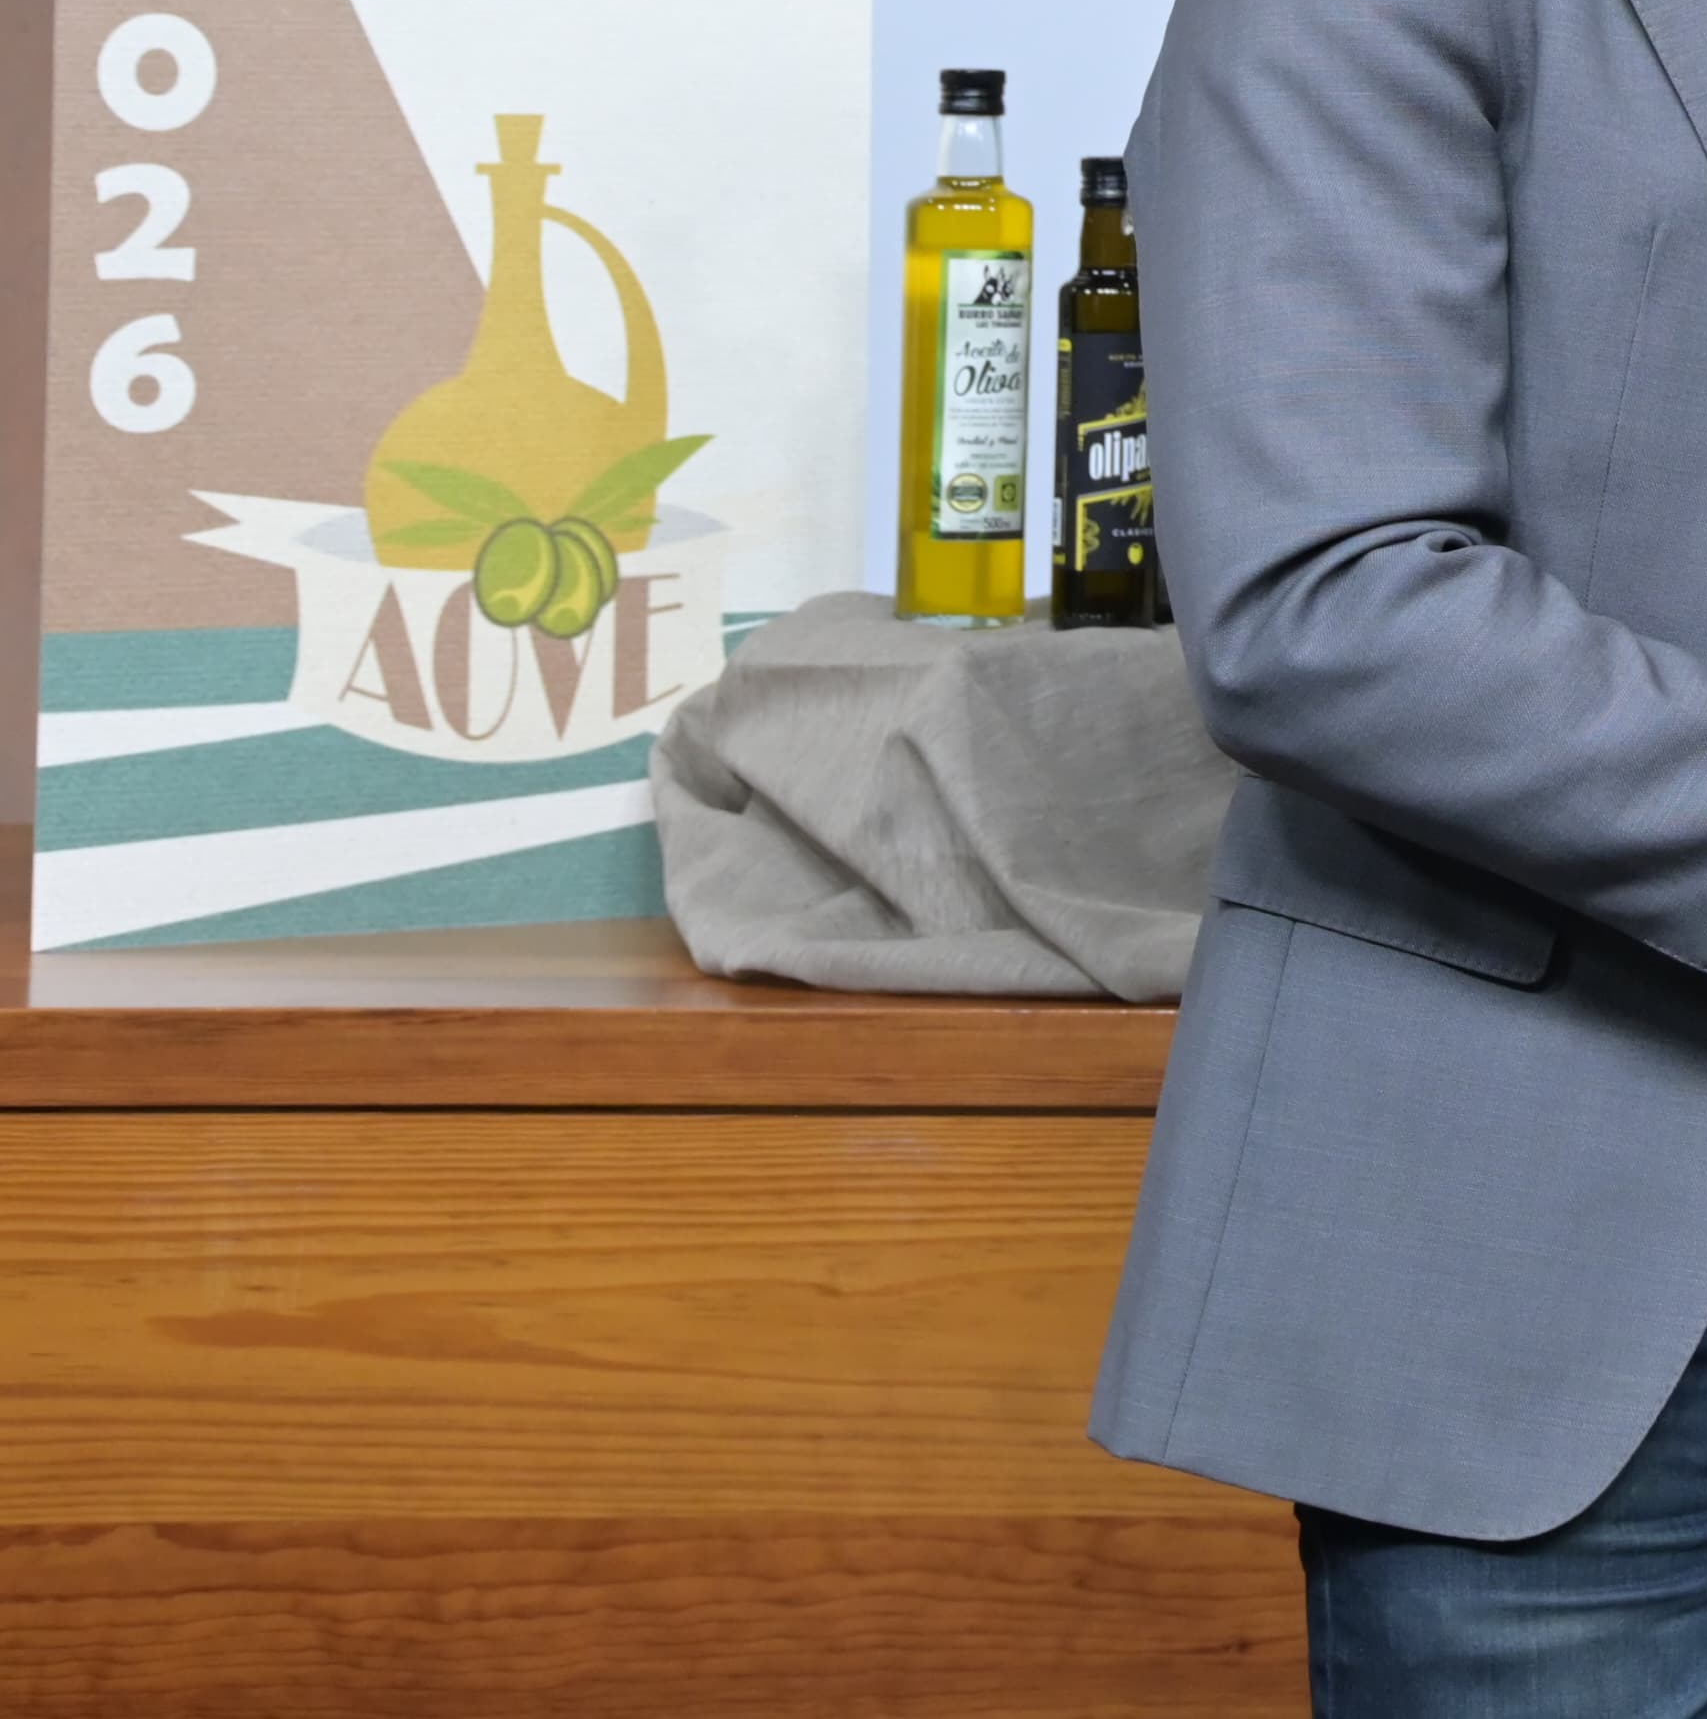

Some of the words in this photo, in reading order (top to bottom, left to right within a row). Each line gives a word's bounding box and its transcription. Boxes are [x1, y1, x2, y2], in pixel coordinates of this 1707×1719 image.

[953, 359, 1021, 396] Oliva
[1088, 431, 1149, 482] olipa
[339, 573, 684, 742] AOVE
